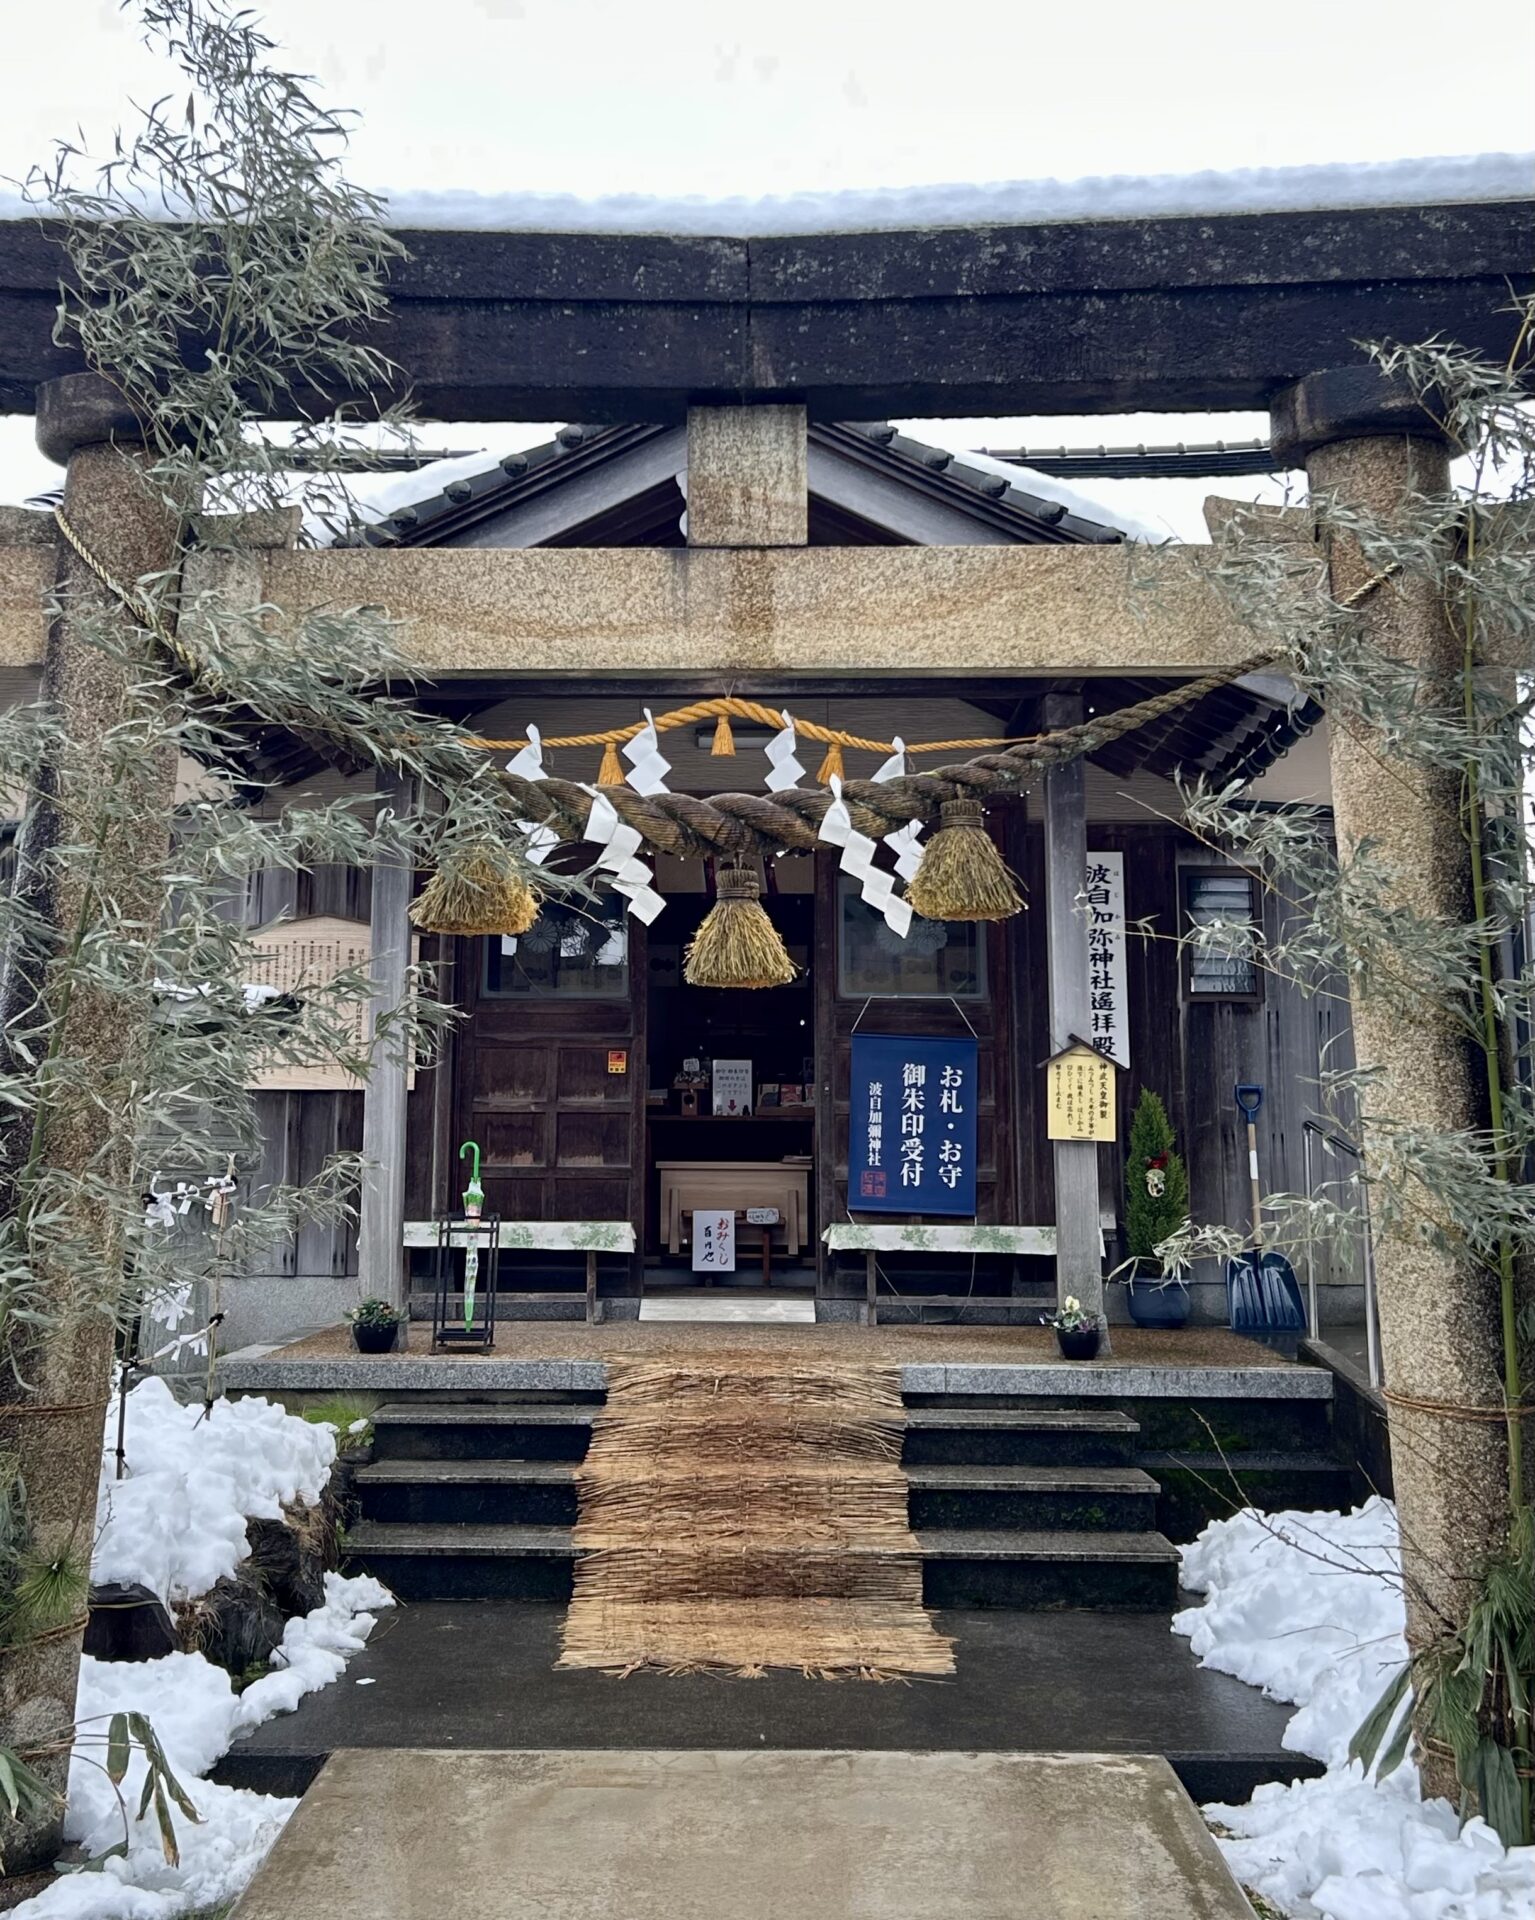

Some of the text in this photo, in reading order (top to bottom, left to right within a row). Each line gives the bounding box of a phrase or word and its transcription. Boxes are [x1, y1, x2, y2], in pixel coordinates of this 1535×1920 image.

[900, 1063, 926, 1187] 御朱印受付
[938, 1065, 964, 1189] お札・お守
[716, 1217, 730, 1265] おみくじ
